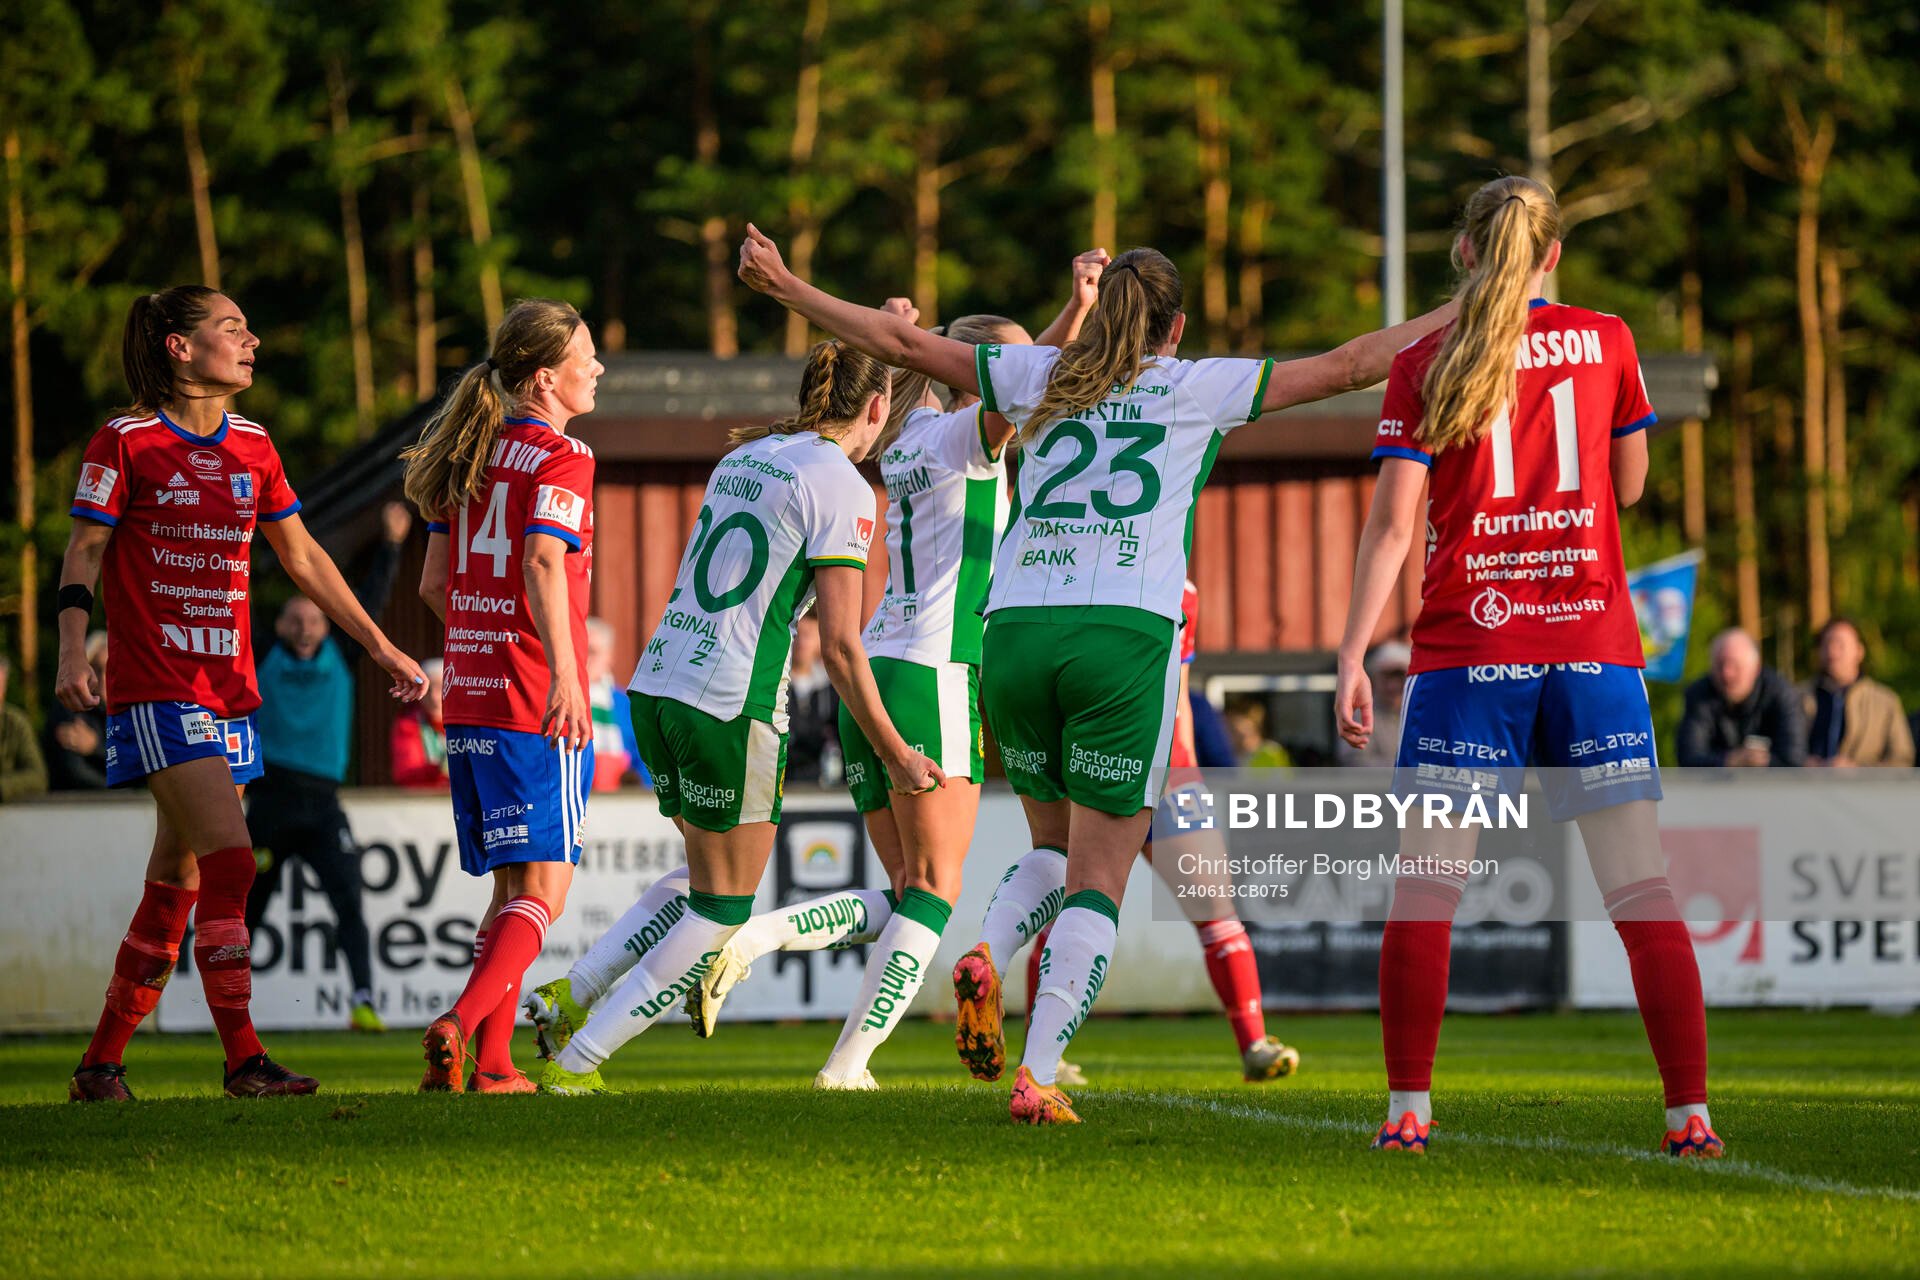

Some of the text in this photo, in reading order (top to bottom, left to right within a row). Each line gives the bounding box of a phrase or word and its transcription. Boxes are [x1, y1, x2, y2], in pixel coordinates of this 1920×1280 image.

[1491, 377, 1581, 498] 11
[1025, 420, 1167, 519] 23
[174, 490, 199, 499] INTER
[713, 474, 763, 502] HASUND
[456, 481, 513, 578] 14
[1472, 506, 1595, 537] furninova
[152, 547, 205, 573] Vittsjö
[1021, 547, 1077, 566] BANK
[1465, 547, 1599, 570] Motorcentrum
[1475, 567, 1548, 581] Markaryd
[1551, 565, 1575, 578] AB
[182, 602, 233, 618] Sparbank
[1512, 599, 1606, 616] MUSIKHUSET
[663, 608, 718, 640] RGINAL
[159, 623, 240, 657] NIBE
[452, 673, 512, 690] MUSIKHUSET
[1069, 758, 1131, 782] gruppen
[1071, 743, 1143, 775] factoring
[482, 804, 527, 822] LATEK
[794, 898, 868, 935] Clinton
[864, 950, 920, 1030] Clinton
